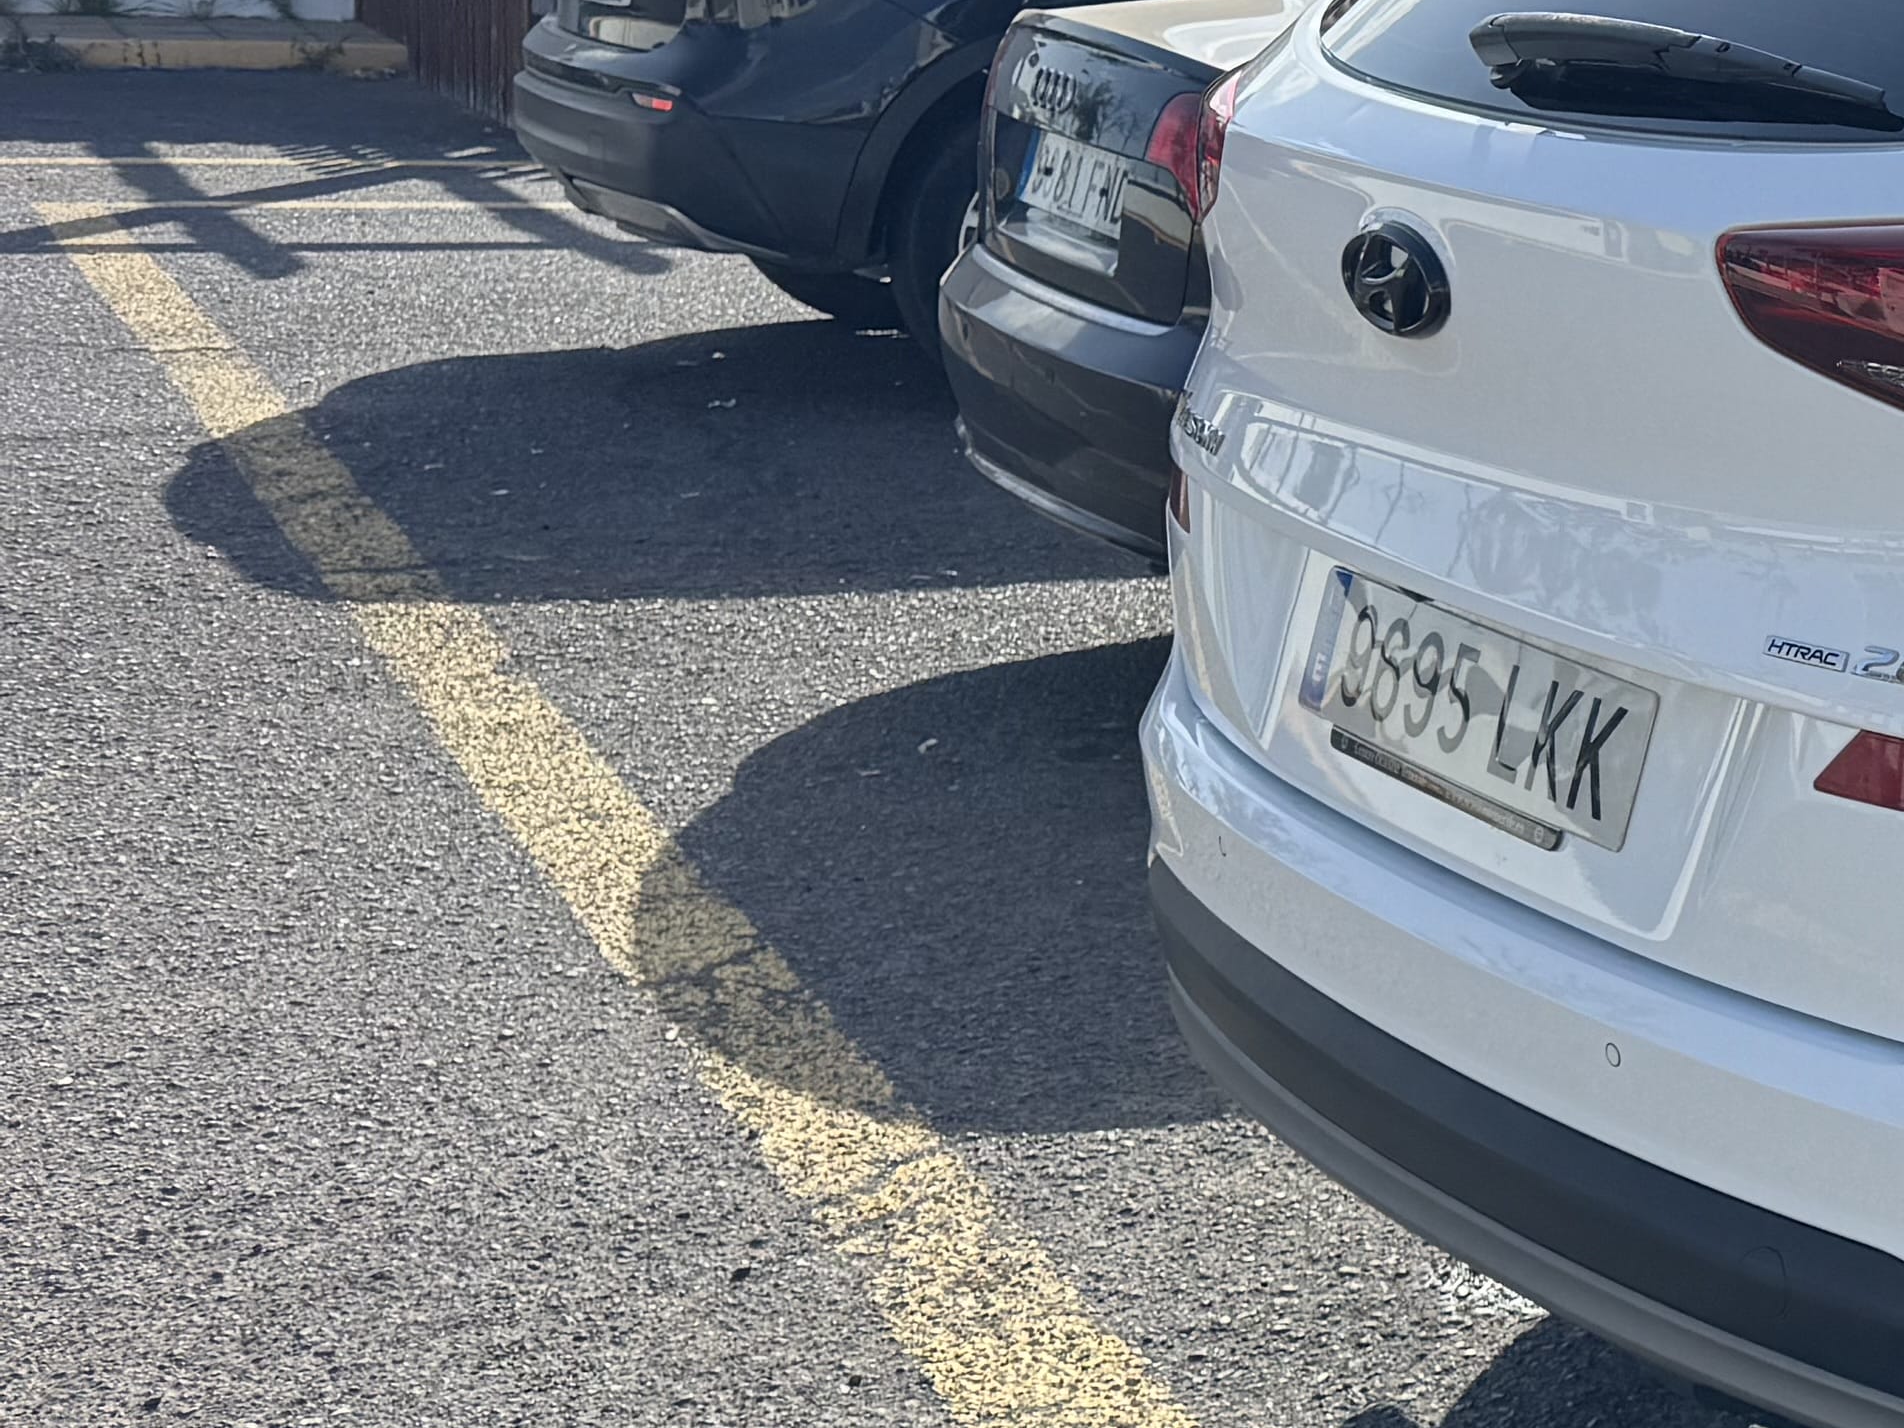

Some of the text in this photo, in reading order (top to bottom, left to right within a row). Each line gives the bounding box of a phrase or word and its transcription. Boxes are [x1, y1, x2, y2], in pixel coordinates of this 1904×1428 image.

[1341, 605, 1481, 755] 9695
[1486, 664, 1629, 821] LKK
[1767, 638, 1840, 667] HTRAC
